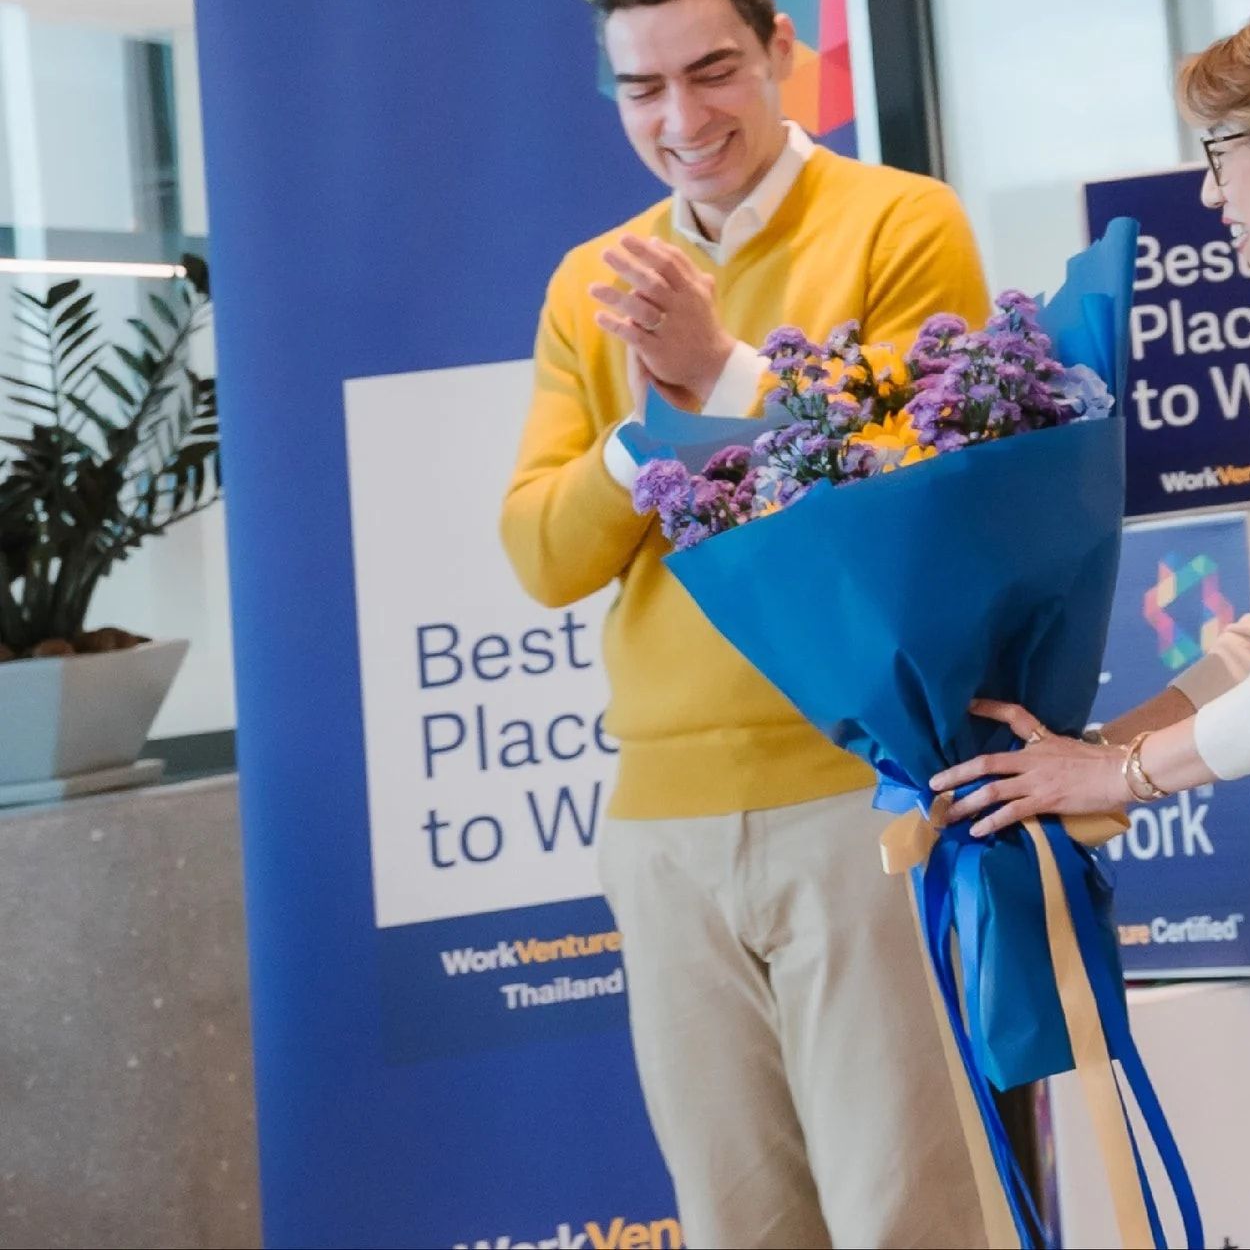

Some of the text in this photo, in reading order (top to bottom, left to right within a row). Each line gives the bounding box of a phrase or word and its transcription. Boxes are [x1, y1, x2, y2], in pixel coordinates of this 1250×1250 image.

[1131, 378, 1201, 431] to
[416, 610, 593, 690] Best
[421, 809, 505, 870] to
[1107, 789, 1215, 863] ork
[440, 930, 623, 976] WorkVenture
[500, 967, 624, 1010] Thailand
